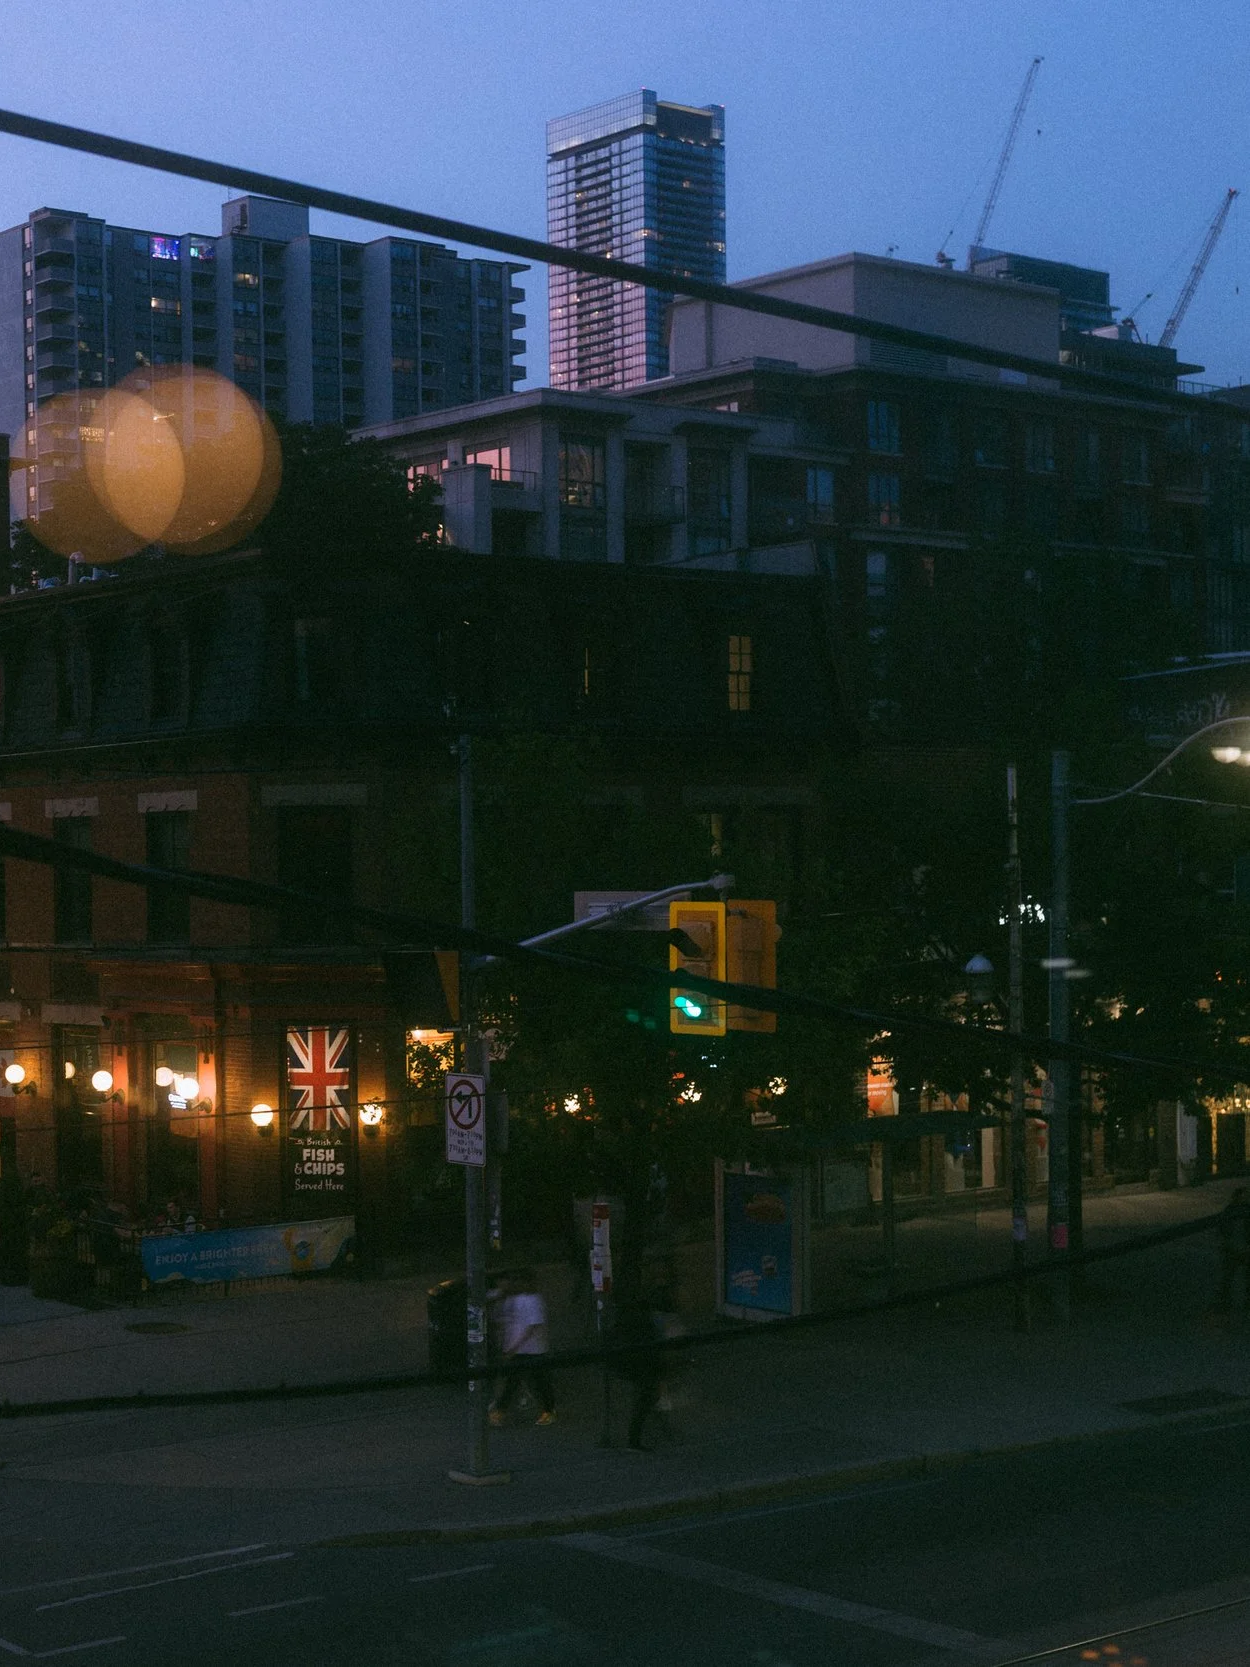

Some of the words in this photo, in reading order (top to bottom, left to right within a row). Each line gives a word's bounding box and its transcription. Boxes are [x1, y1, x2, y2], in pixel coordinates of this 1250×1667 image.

[306, 1136, 331, 1146] British
[302, 1148, 335, 1162] FISH
[293, 1162, 303, 1175] &
[303, 1162, 345, 1176] CHIPS
[294, 1177, 323, 1191] Served
[324, 1178, 345, 1191] Here
[155, 1252, 189, 1265] ENJOY
[190, 1252, 198, 1263] A
[200, 1246, 250, 1261] BRIGHTER
